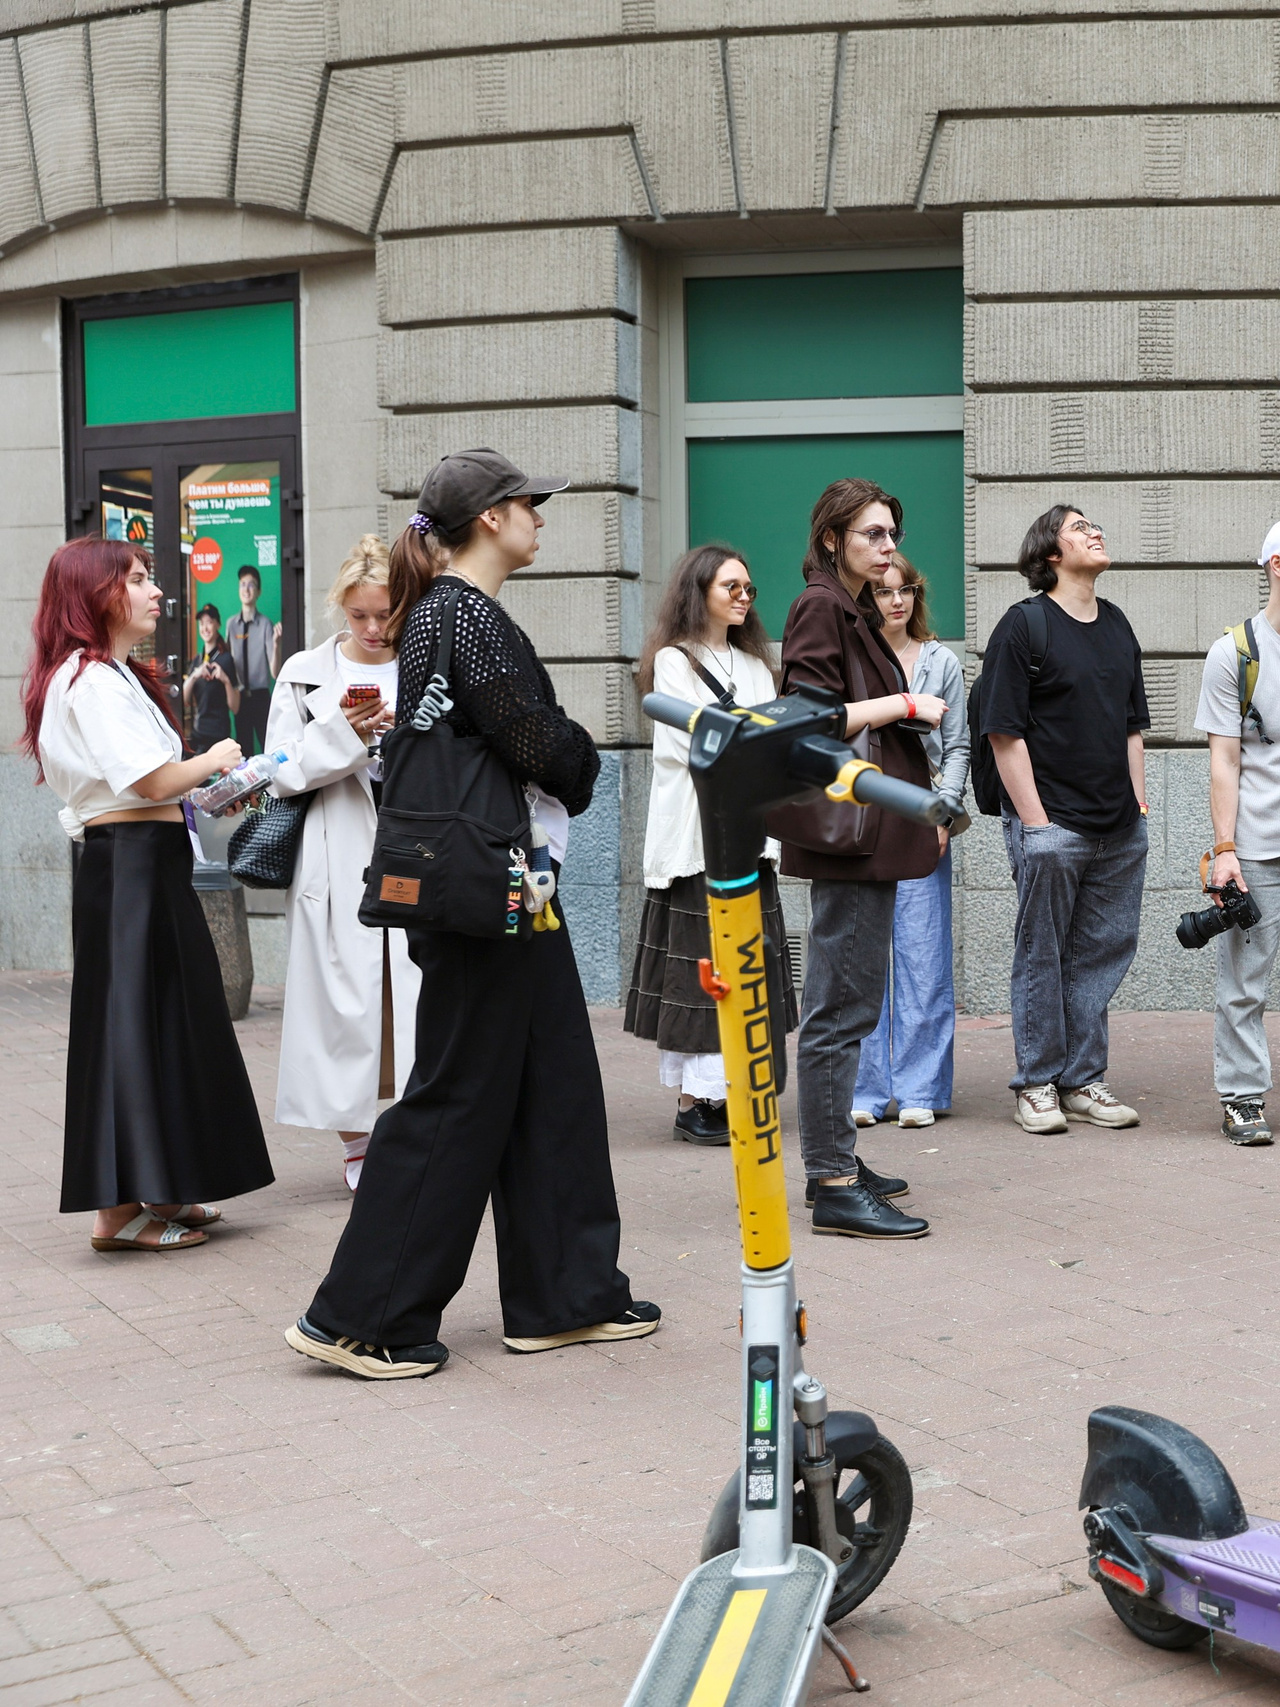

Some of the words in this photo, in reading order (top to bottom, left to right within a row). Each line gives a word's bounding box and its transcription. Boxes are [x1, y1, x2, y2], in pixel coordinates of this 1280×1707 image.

[189, 484, 226, 496] Платим
[227, 482, 270, 494] больше,
[189, 499, 209, 510] чем
[210, 498, 224, 509] ты
[225, 496, 271, 511] думаешь
[505, 892, 521, 934] LOVE
[737, 933, 778, 1165] WHOOSH
[758, 1387, 768, 1415] Прайм
[748, 1445, 777, 1453] старты
[754, 1438, 770, 1446] Все
